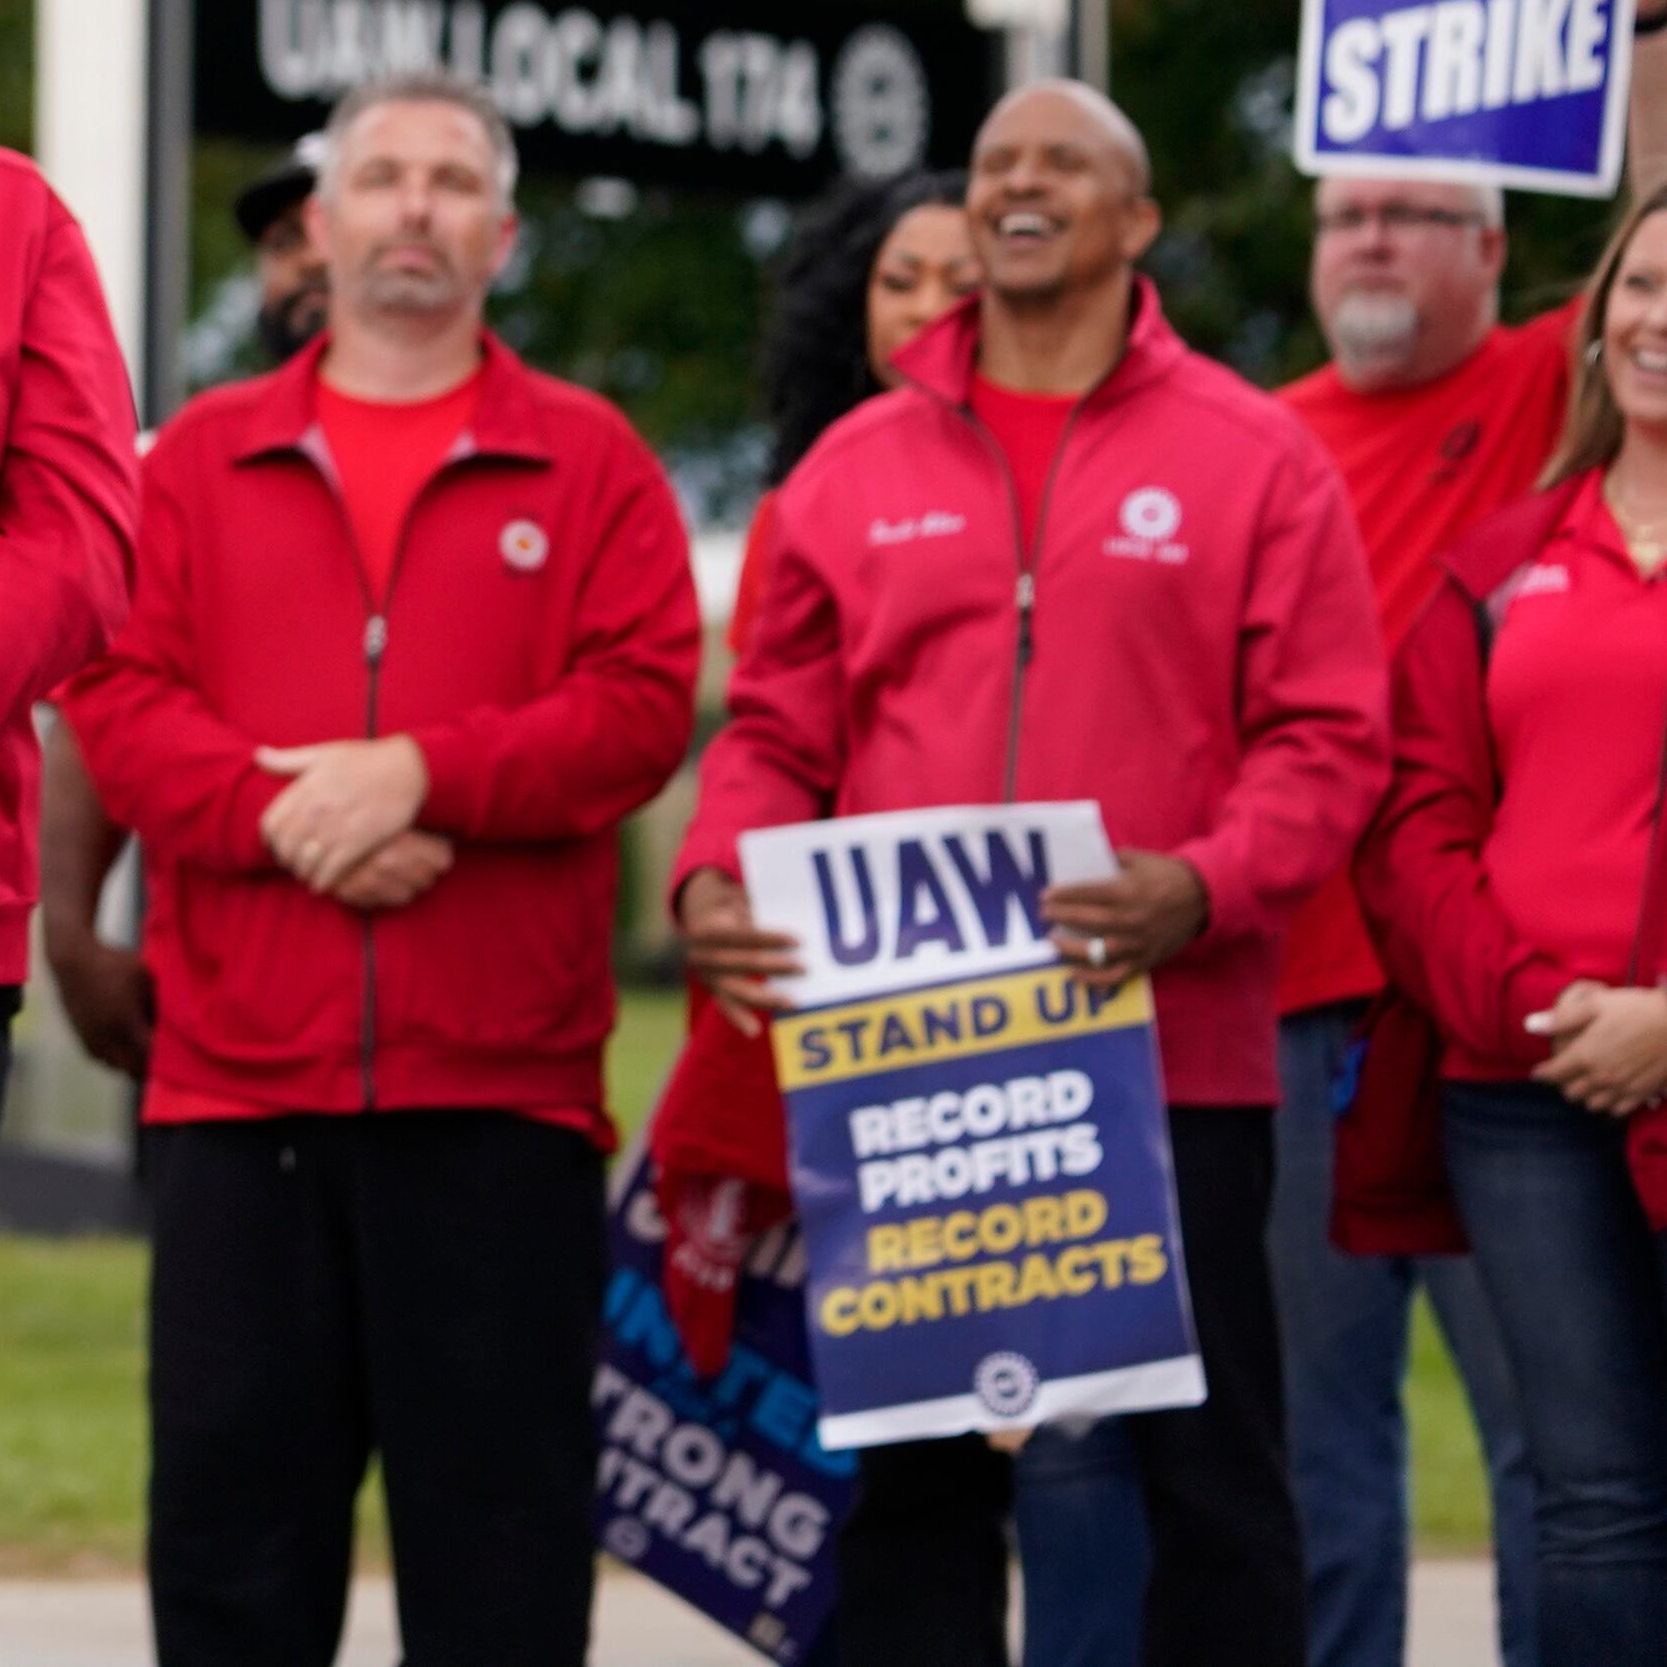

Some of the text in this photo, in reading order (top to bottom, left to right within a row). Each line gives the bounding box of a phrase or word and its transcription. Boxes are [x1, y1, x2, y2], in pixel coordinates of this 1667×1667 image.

[700, 29, 820, 160] 174
[812, 828, 1050, 967] UAW
[799, 979, 1123, 1072] STAND UP
[849, 1069, 1094, 1160] RECORD
[858, 1122, 1104, 1214] PROFITS
[868, 1188, 1109, 1273] RECORD
[819, 1233, 1168, 1338] CONTRACTS
[589, 1364, 831, 1561] TRONG
